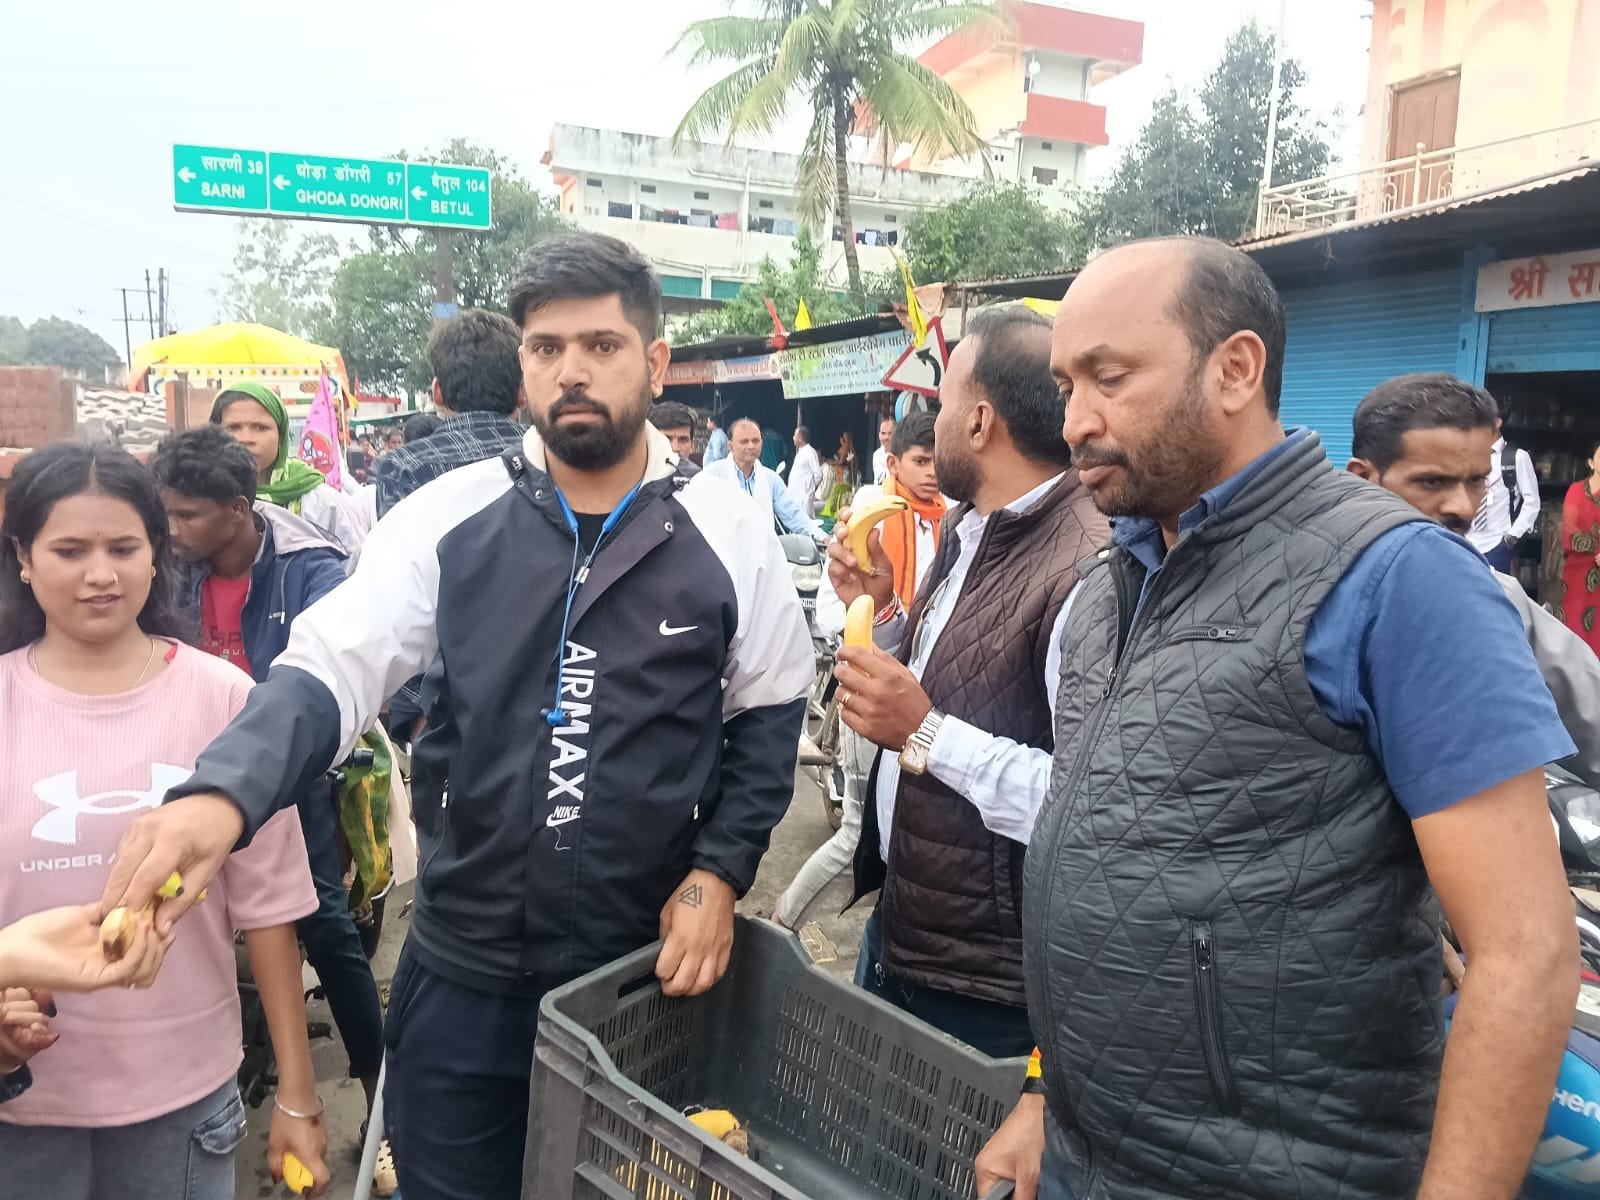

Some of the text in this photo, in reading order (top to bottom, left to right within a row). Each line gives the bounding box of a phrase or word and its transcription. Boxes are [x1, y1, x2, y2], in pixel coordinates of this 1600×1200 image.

[200, 152, 243, 174] सारणी
[201, 181, 246, 199] SARNI
[466, 178, 486, 193] 104
[295, 188, 403, 212] GHODA DONGRI
[430, 200, 474, 217] BETUL
[1507, 256, 1549, 301] श्री
[547, 640, 598, 802] AIRMAX
[551, 805, 581, 819] NIKE
[20, 854, 103, 873] UNDER
